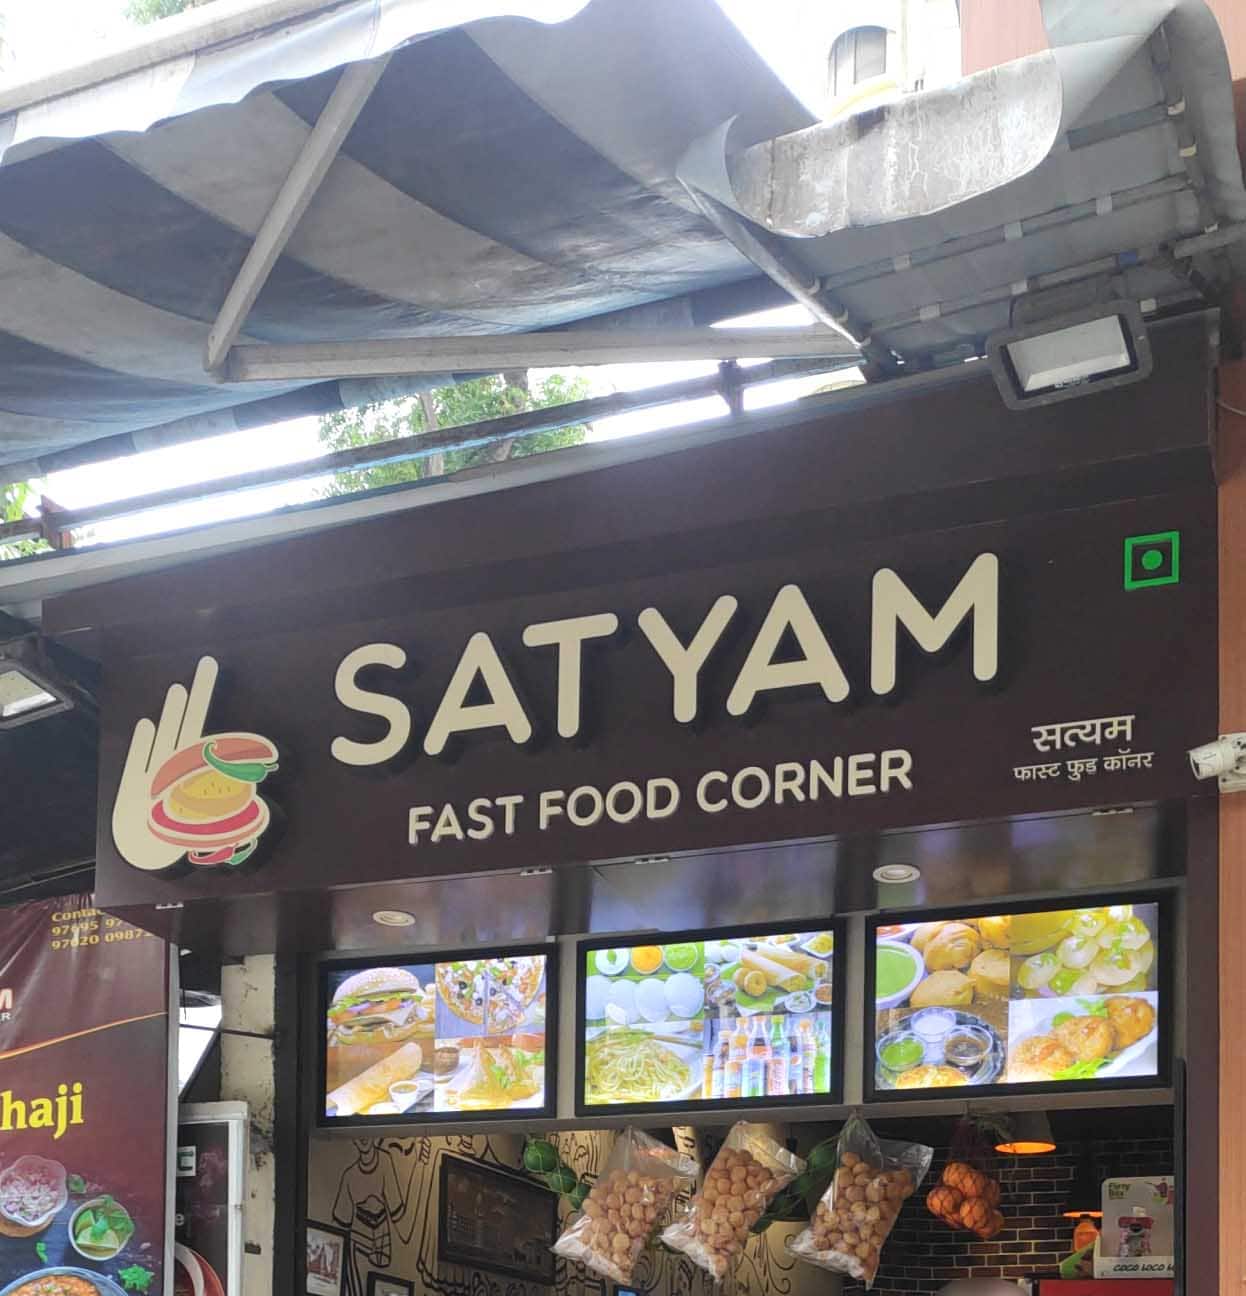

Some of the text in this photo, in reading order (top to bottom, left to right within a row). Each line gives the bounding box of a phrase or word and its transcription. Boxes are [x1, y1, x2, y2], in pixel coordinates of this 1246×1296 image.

[331, 553, 998, 767] SATYAM
[1013, 762, 1062, 781] फास्ट
[1103, 748, 1155, 773] कॉनर
[1031, 714, 1136, 752] सत्यम
[407, 749, 913, 847] FAST FOOD CORNER
